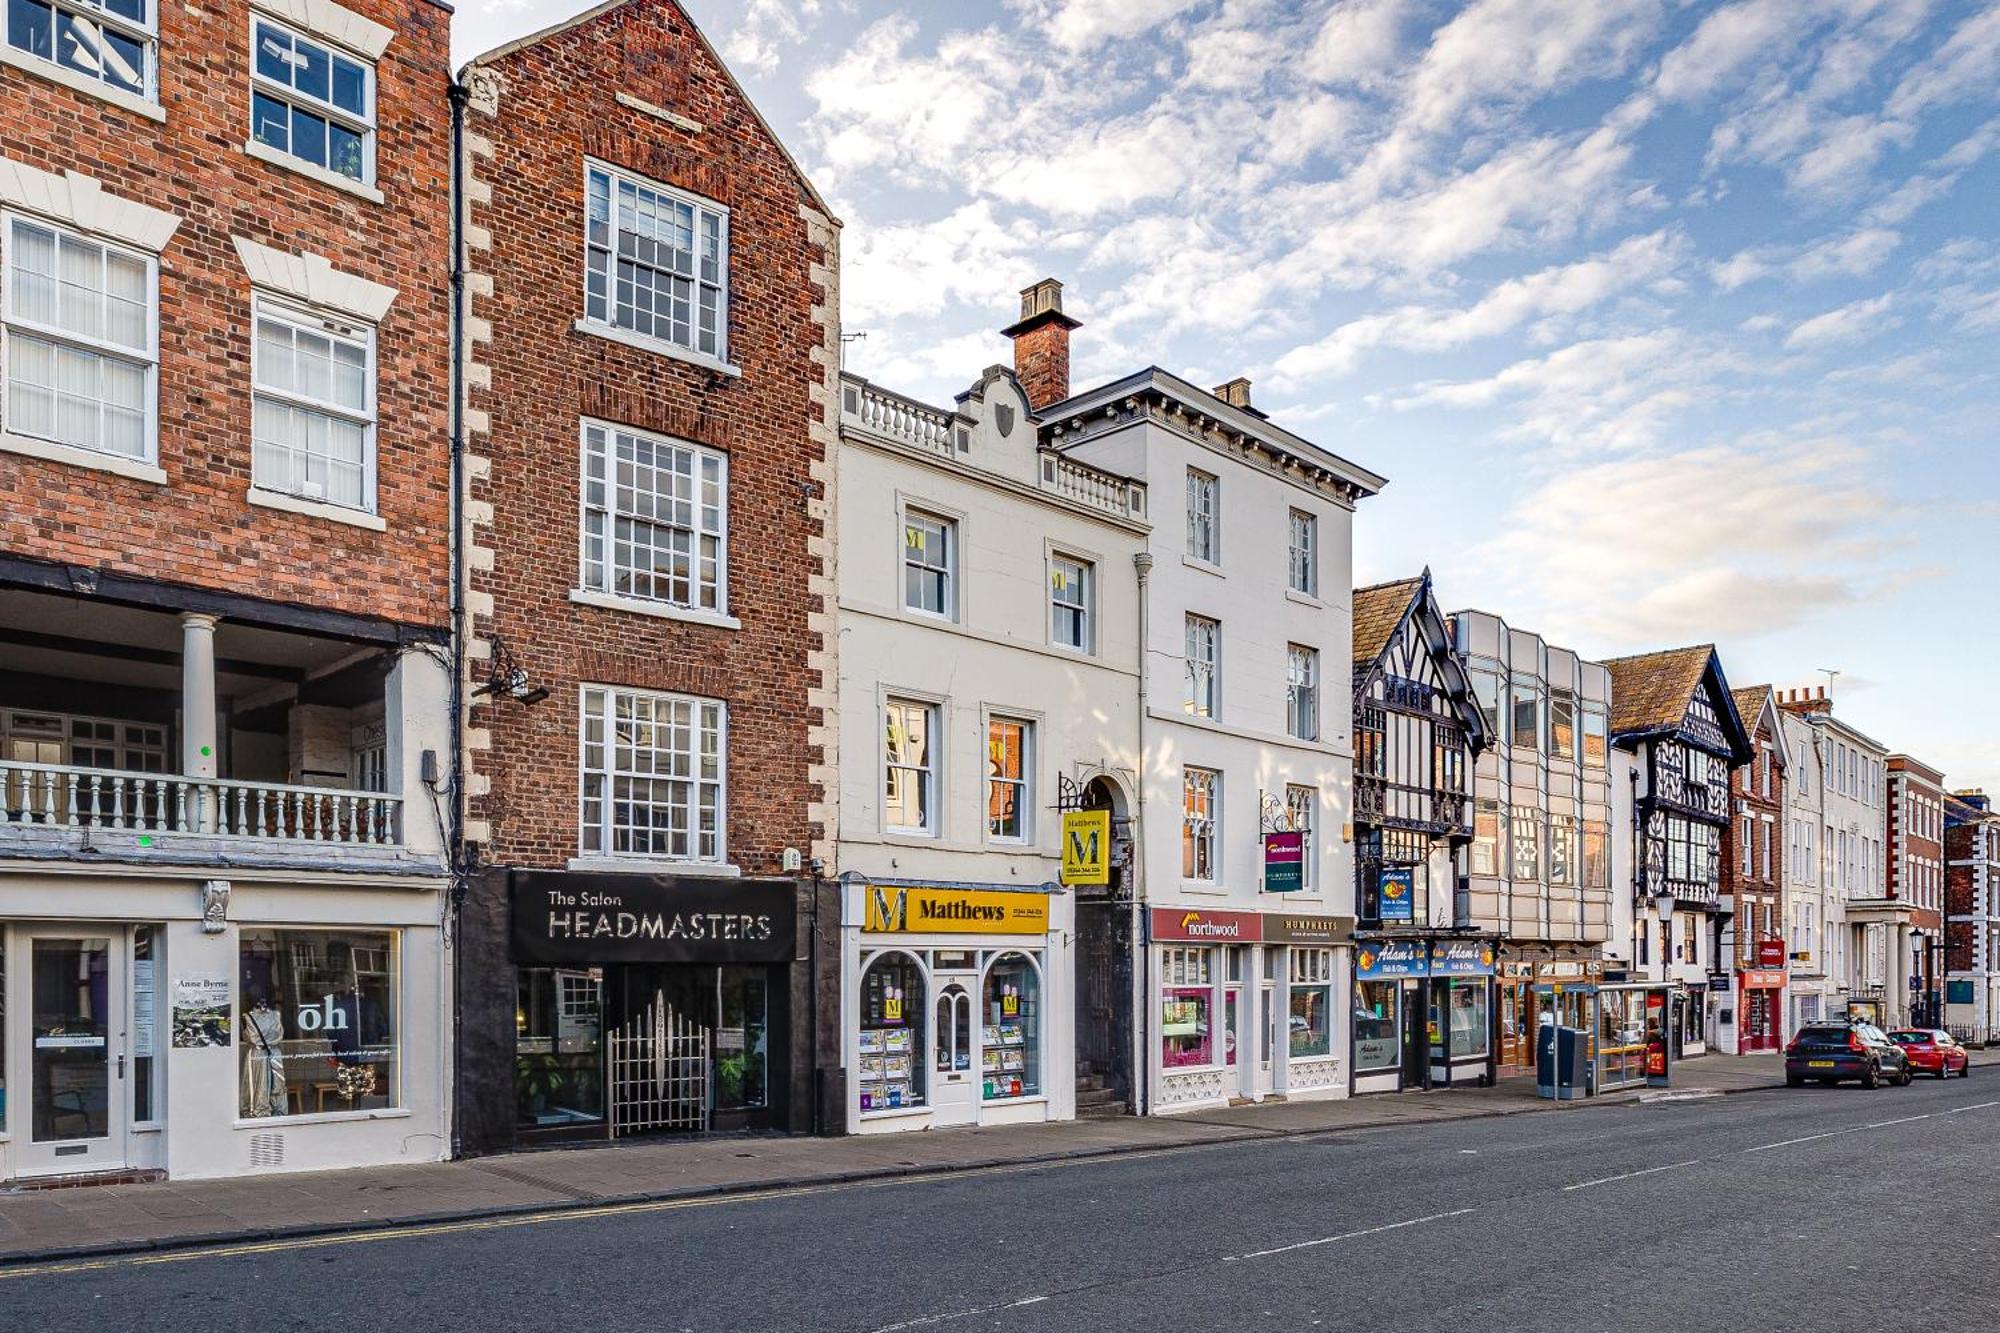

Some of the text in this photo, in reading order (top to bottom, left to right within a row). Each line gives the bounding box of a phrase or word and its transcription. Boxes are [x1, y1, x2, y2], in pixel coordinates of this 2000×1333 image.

[1068, 830, 1100, 864] M
[548, 891, 622, 907] The Salon
[872, 888, 907, 931] M
[919, 899, 1005, 921] Matthews
[548, 911, 772, 941] HEADMASTERS
[1188, 920, 1239, 937] northwood
[1284, 920, 1337, 930] HUMPHREYS
[1377, 943, 1414, 962] Adam's
[1446, 943, 1479, 960] Adam's
[1382, 964, 1392, 973] Fish
[203, 979, 229, 989] Byrne
